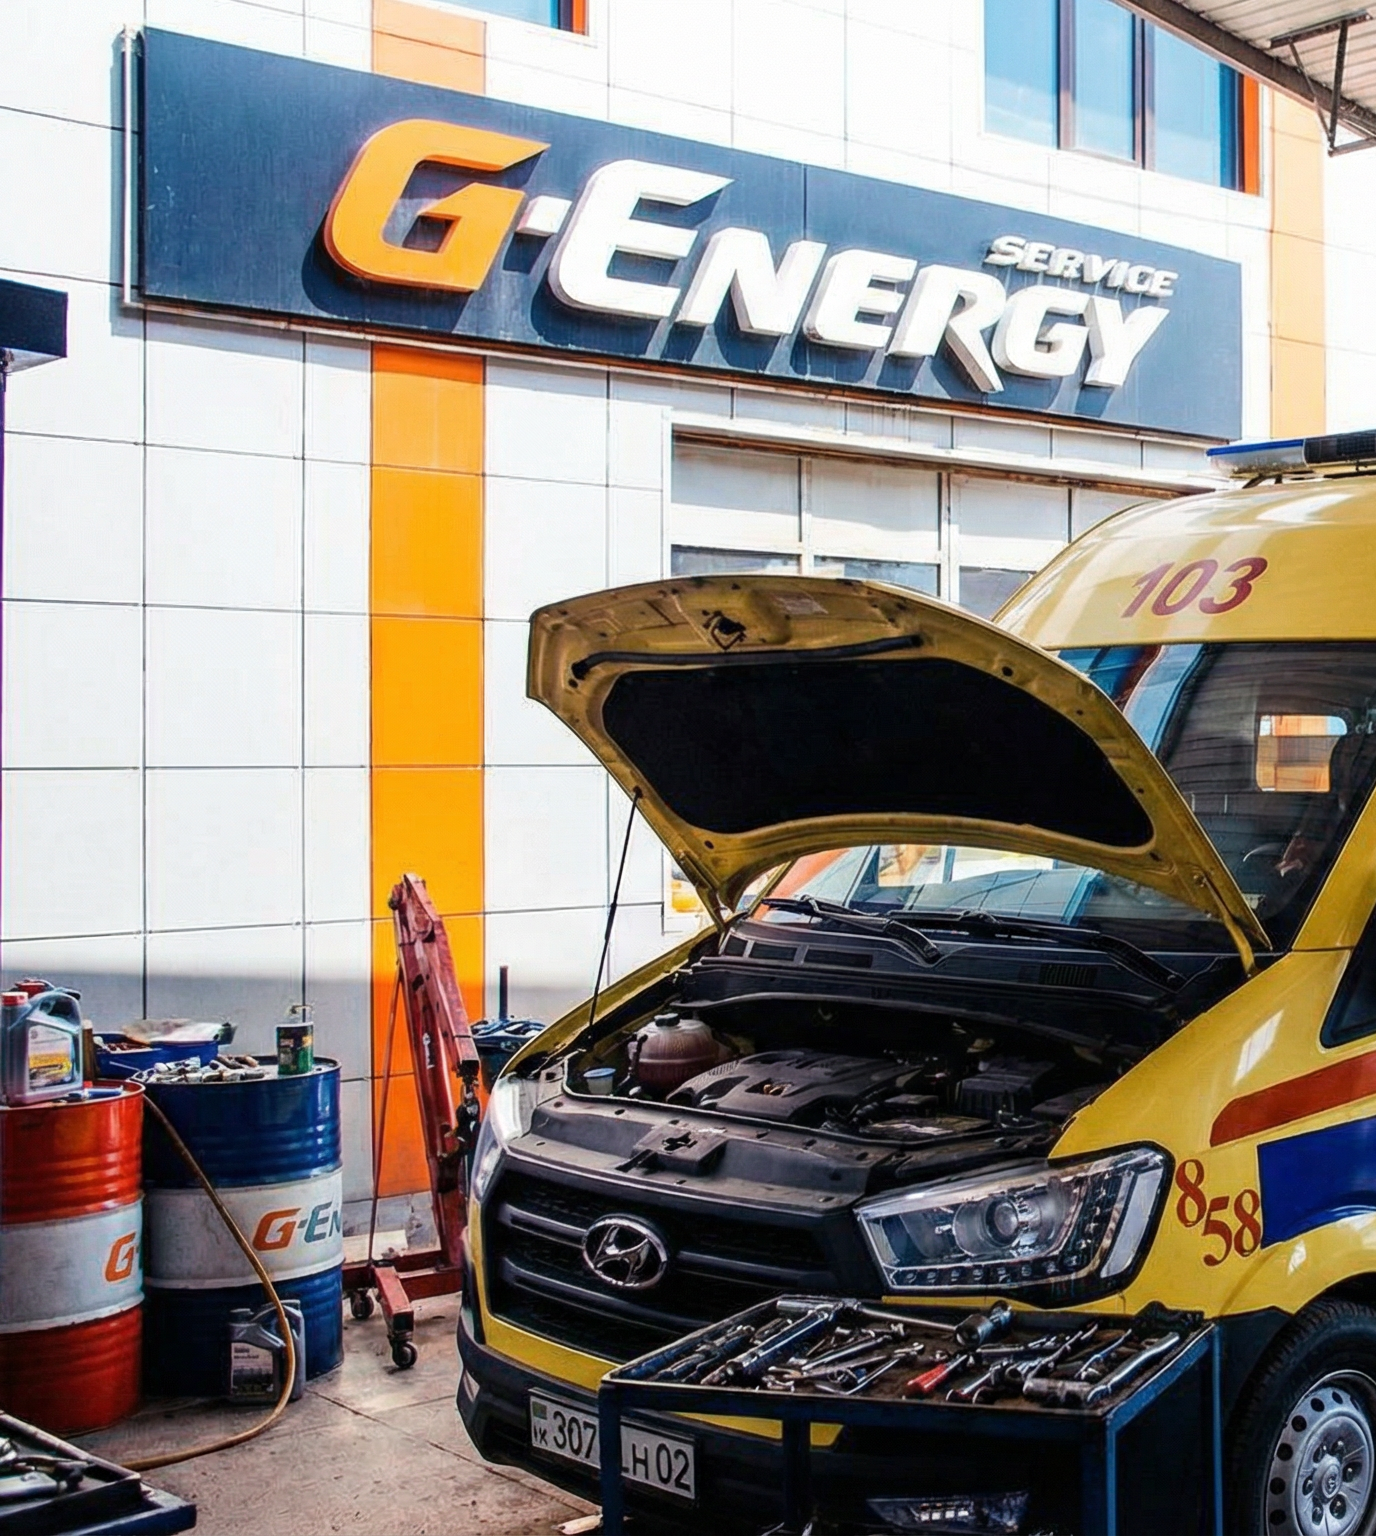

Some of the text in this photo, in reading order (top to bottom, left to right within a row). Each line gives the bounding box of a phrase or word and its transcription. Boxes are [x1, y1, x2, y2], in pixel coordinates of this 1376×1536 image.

[324, 118, 1171, 394] G-ENERGY
[984, 235, 1178, 297] SERVICE
[1121, 557, 1268, 618] 103
[553, 1410, 597, 1459] 307
[656, 1443, 691, 1492] 02
